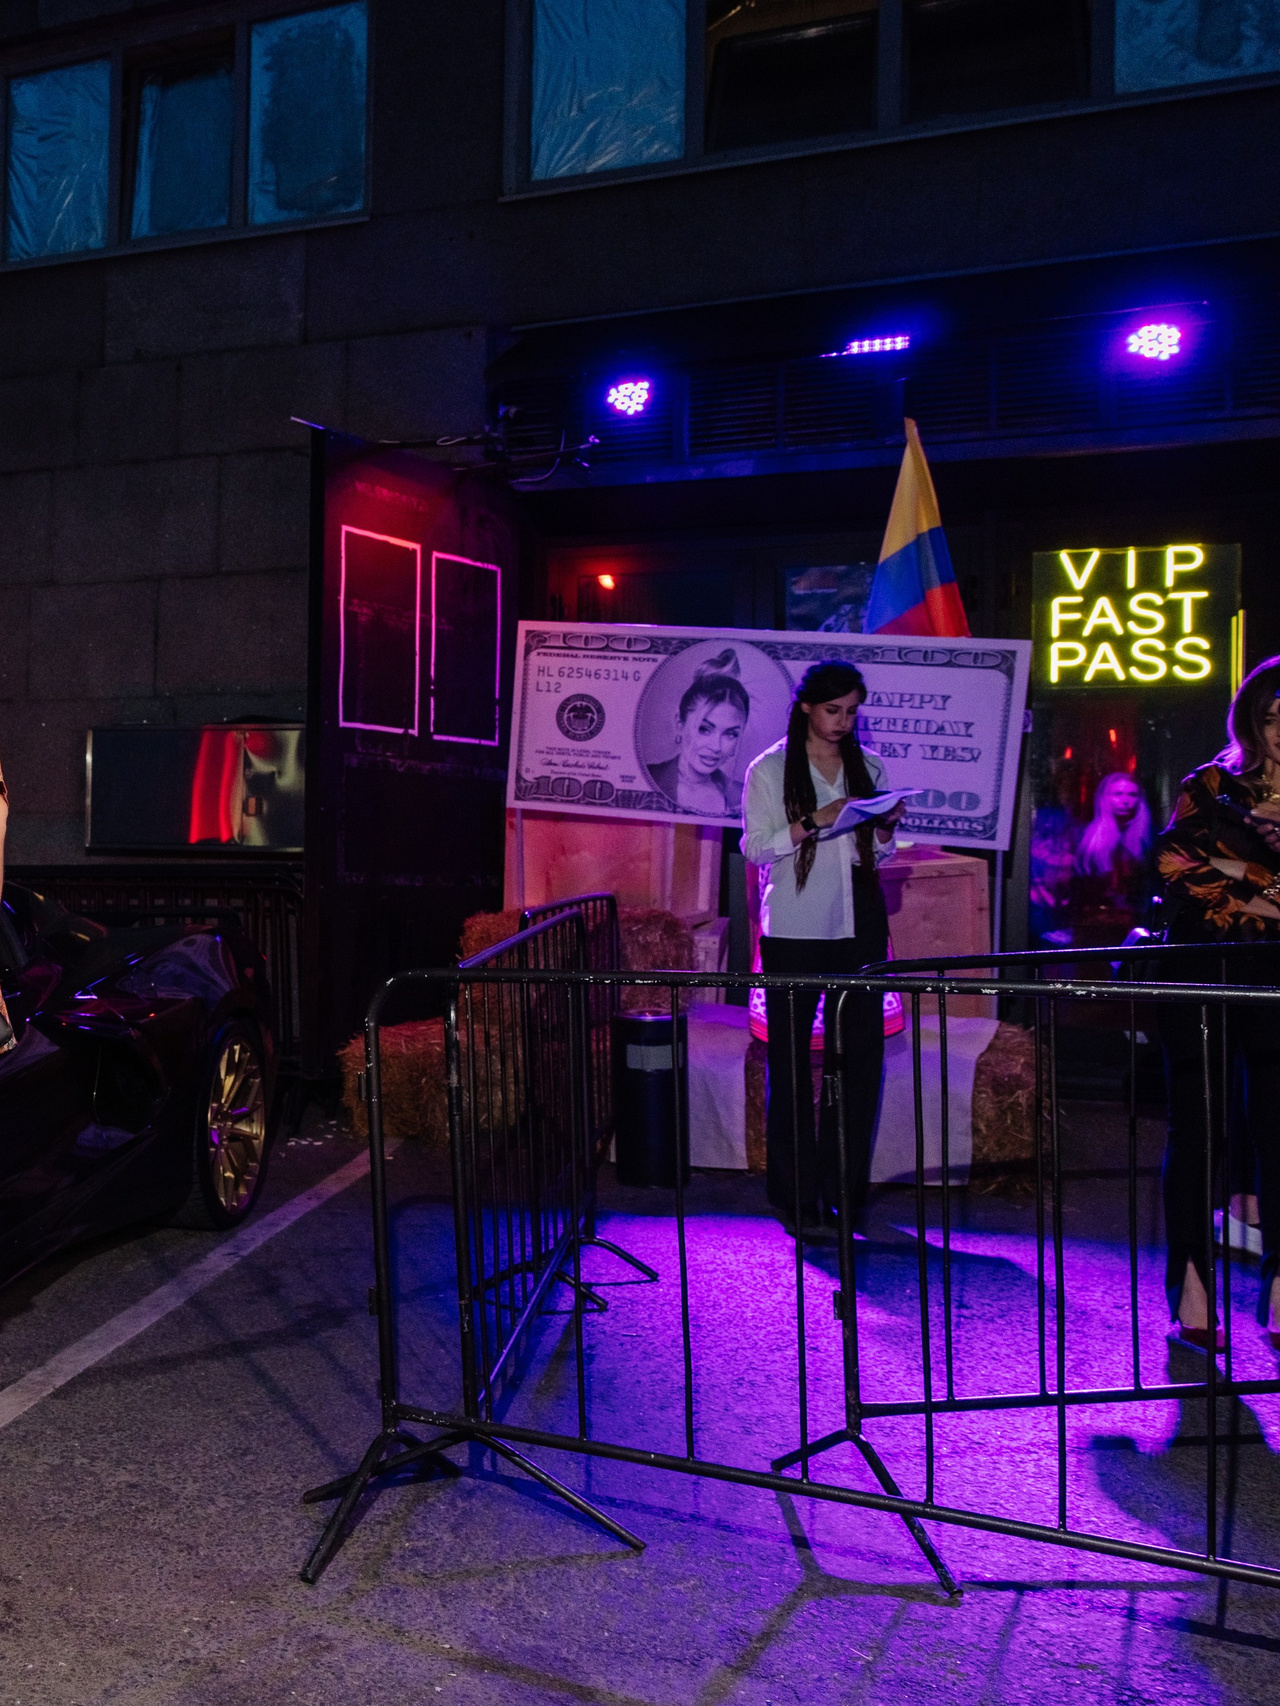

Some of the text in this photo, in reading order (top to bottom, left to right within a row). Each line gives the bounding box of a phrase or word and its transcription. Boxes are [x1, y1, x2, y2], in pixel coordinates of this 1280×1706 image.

[1060, 545, 1204, 590] VIP
[1051, 591, 1209, 638] FAST
[537, 666, 554, 677] HL
[558, 666, 629, 681] 62546314
[1049, 637, 1212, 684] PASS
[536, 681, 561, 693] L12
[534, 775, 616, 802] 100
[905, 789, 980, 811] 00
